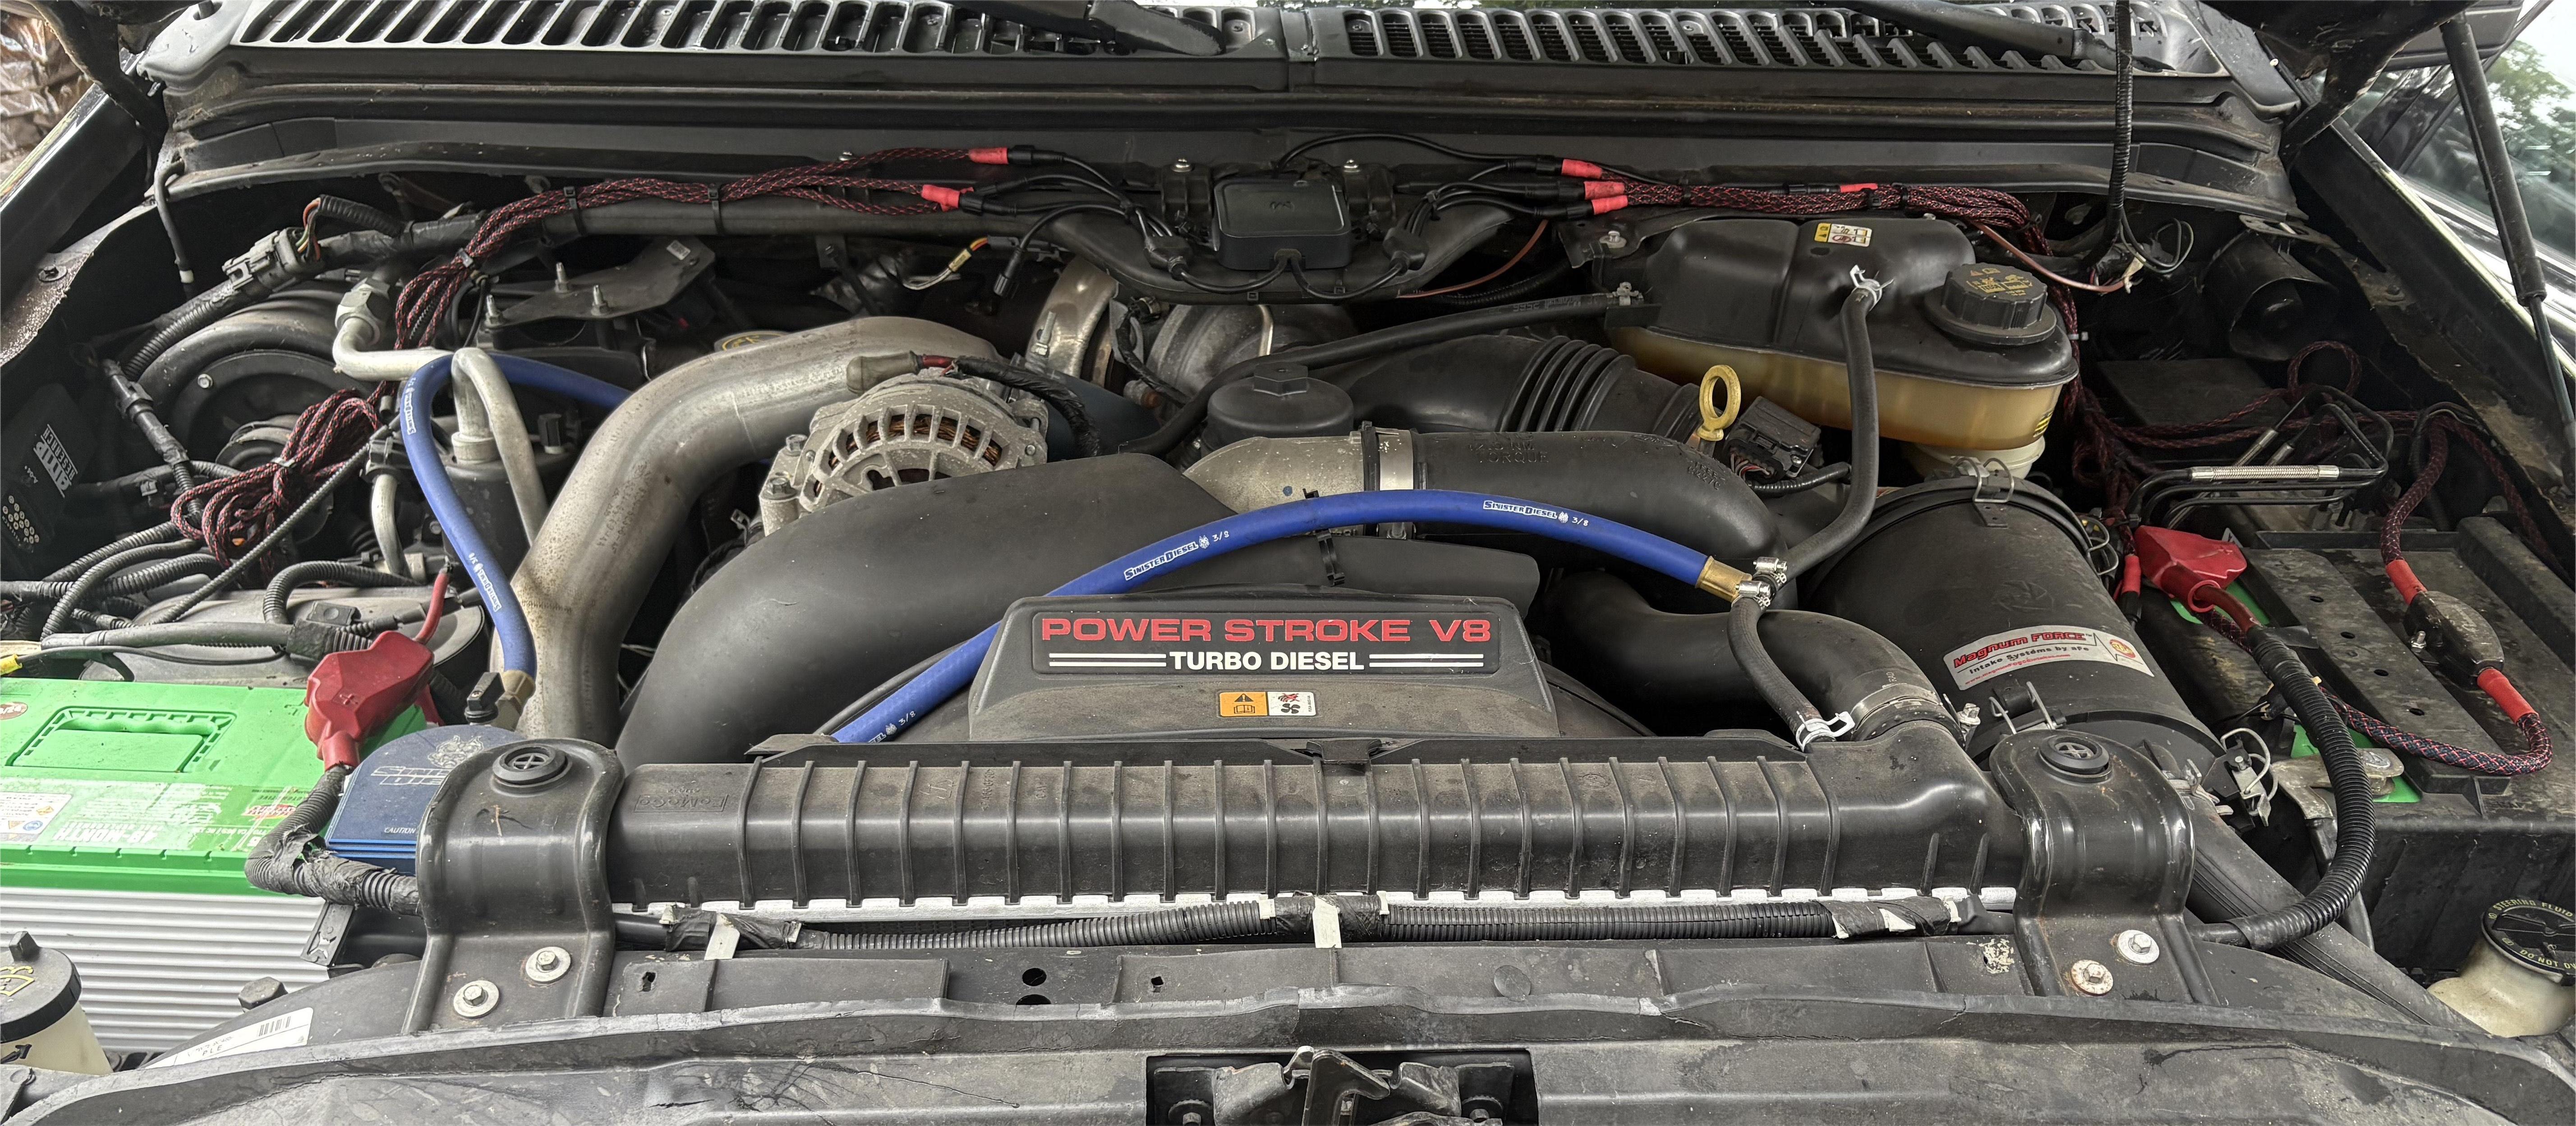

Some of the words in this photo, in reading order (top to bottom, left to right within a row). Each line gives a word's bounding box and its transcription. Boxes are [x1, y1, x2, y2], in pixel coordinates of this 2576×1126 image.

[1475, 451, 1549, 464] ORQUE
[1572, 517, 1589, 526] 3/8
[1212, 531, 1230, 542] 3/8
[1042, 618, 1212, 642] POWER
[1224, 619, 1412, 642] STROKE
[1434, 619, 1492, 642] V8
[1953, 636, 2029, 668] Magnum
[1169, 651, 1262, 671] TURBO
[1270, 651, 1365, 671] DIESEL
[1969, 657, 2003, 674] Intake
[898, 711, 916, 726] 3/8
[2493, 899, 2537, 911] STEERING
[2541, 902, 2573, 917] FLUID
[2519, 949, 2535, 958] DO
[2538, 957, 2558, 967] NOT
